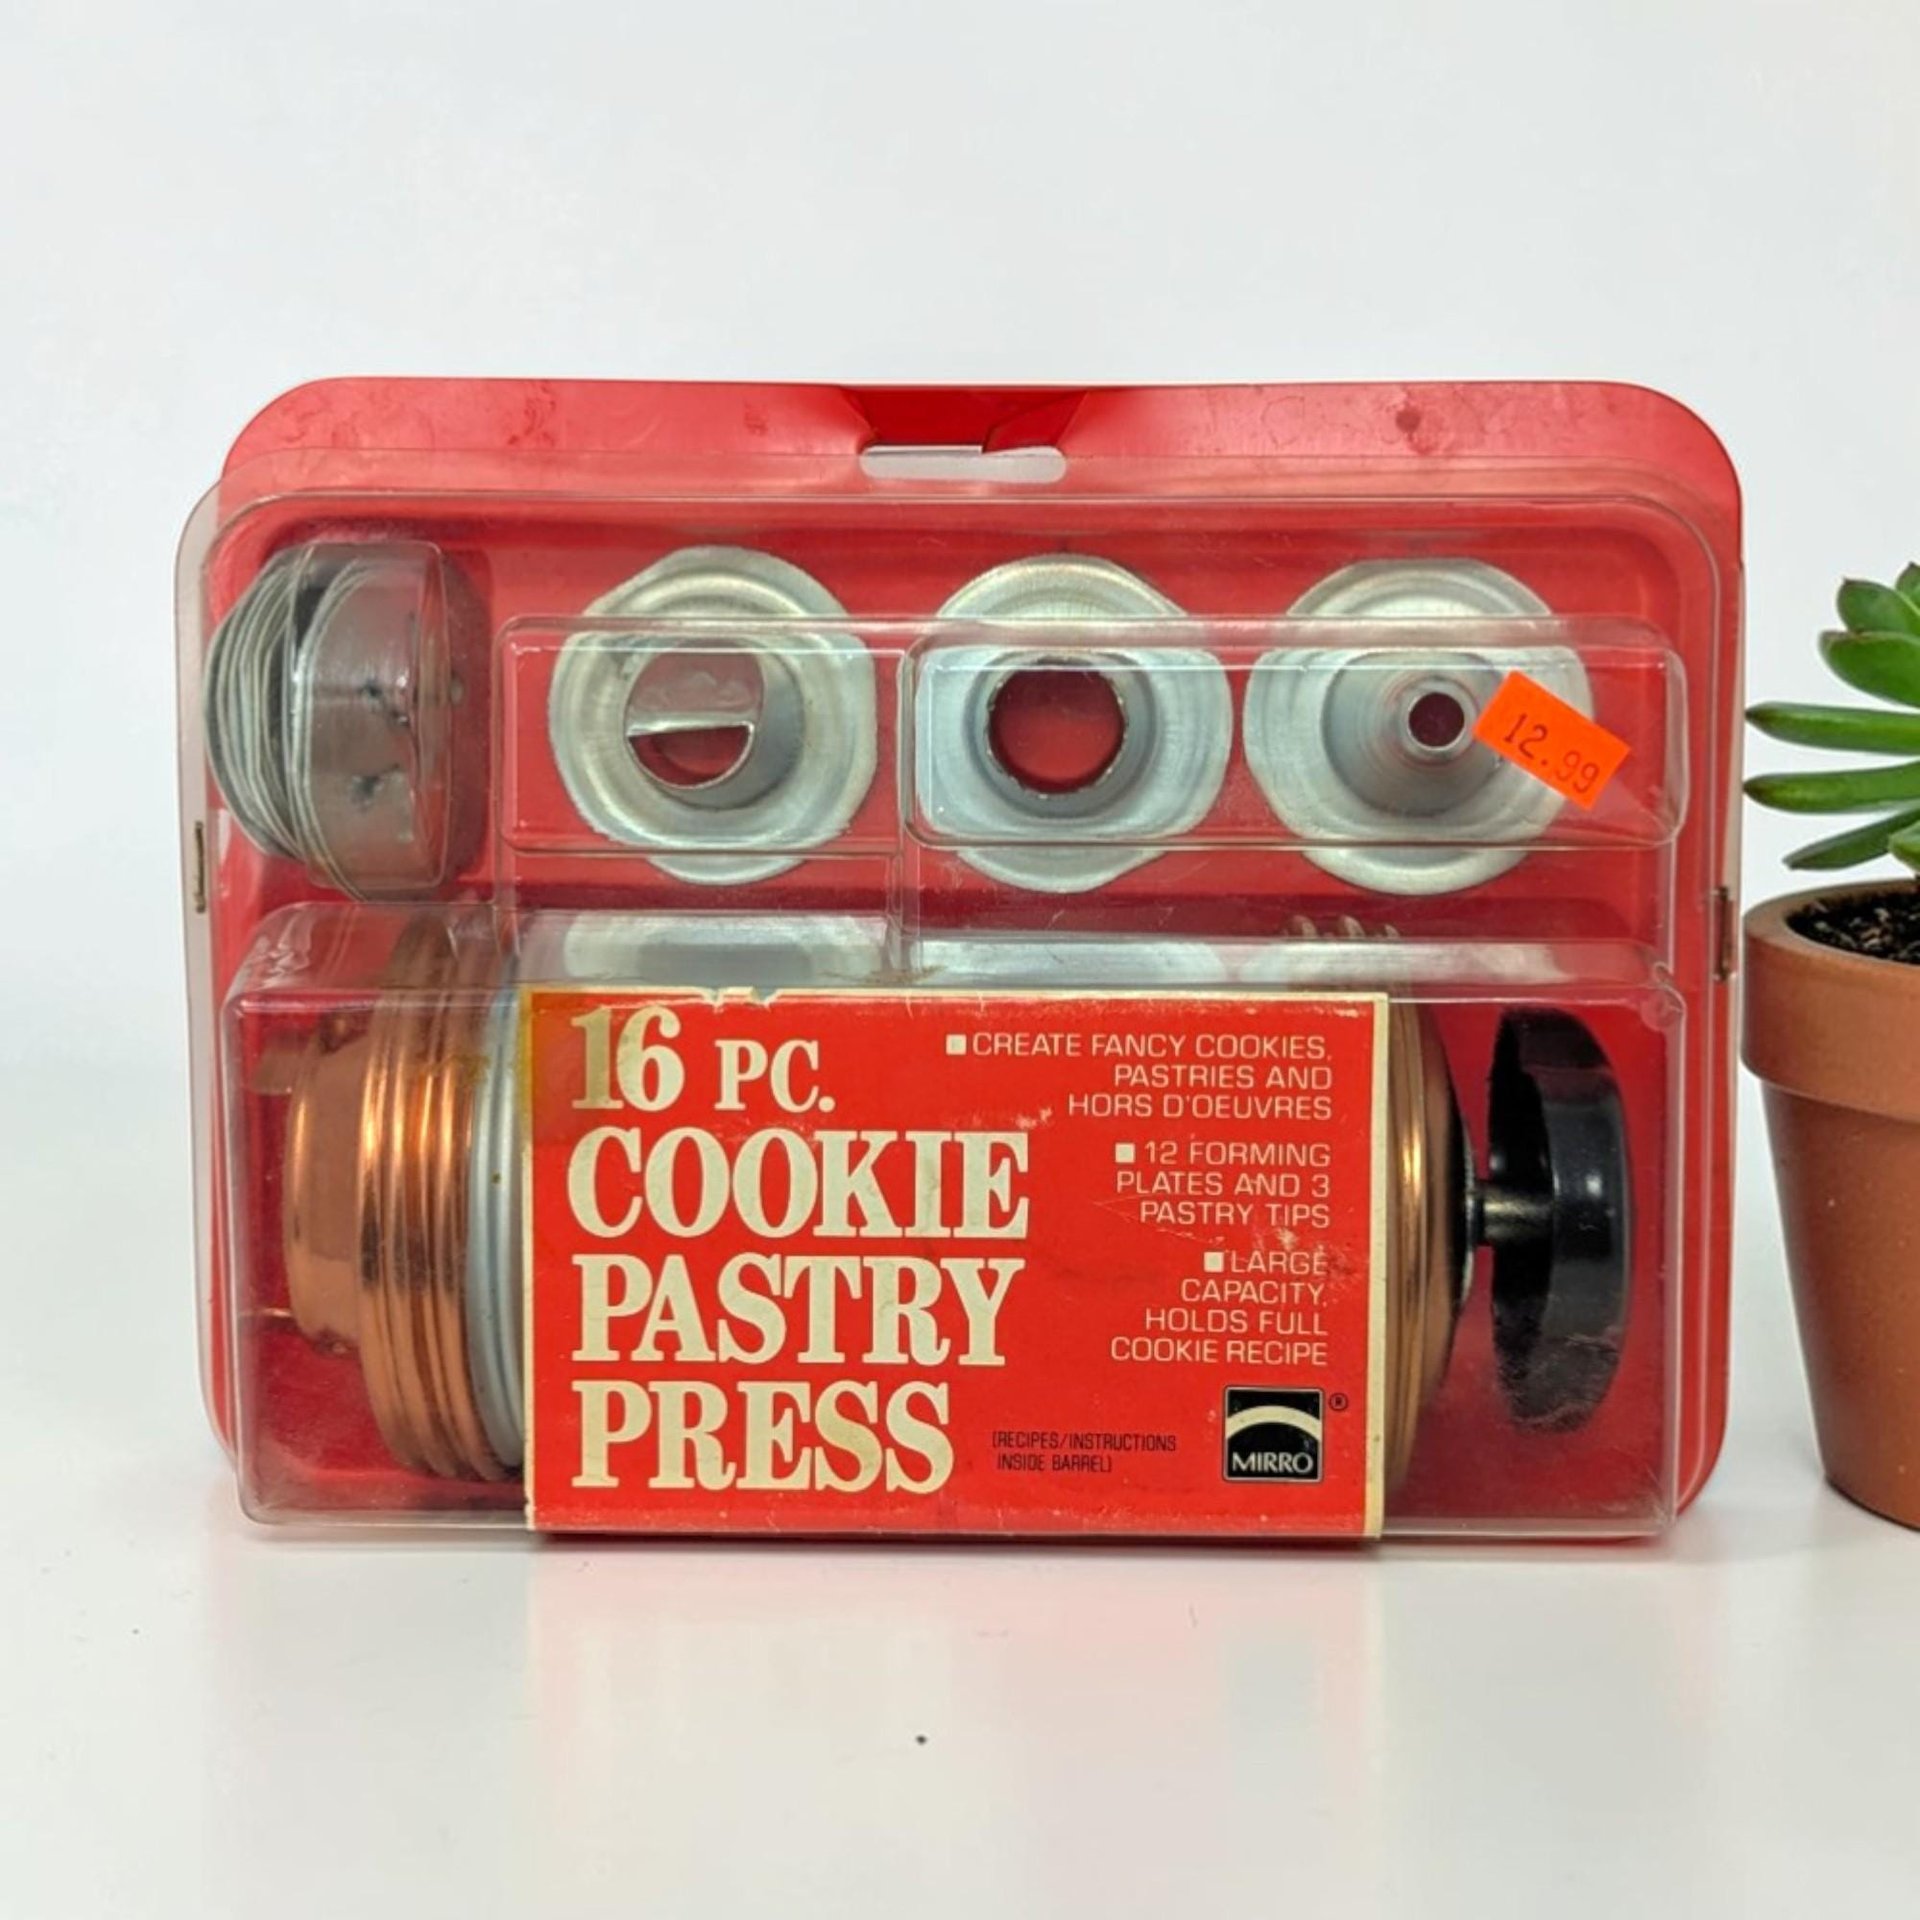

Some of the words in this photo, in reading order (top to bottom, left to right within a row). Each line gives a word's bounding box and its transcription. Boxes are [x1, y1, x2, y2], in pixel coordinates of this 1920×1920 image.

[1503, 712, 1599, 794] 12.99
[973, 1033, 1081, 1056] CREATE
[1091, 1034, 1185, 1058] FANCY
[571, 1006, 685, 1112] 16
[714, 1040, 835, 1112] PC.
[1114, 1064, 1254, 1088] PASTRIES
[1266, 1066, 1332, 1090] AND
[1068, 1094, 1152, 1117] HORS
[1163, 1094, 1332, 1120] D'OEUVRES
[1145, 1141, 1180, 1164] 12
[1189, 1142, 1331, 1167] FORMING
[566, 1127, 1030, 1239] COOKIE
[1116, 1171, 1224, 1195] PLATES
[1234, 1172, 1301, 1197] AND
[1311, 1174, 1330, 1197] 3
[1140, 1202, 1254, 1226] PASTRY
[1264, 1203, 1330, 1228] TIPS
[1231, 1250, 1328, 1275] LARGE
[571, 1252, 1025, 1366] PASTRY
[1145, 1309, 1248, 1333] HOLDS
[1260, 1311, 1328, 1335] FULL
[1110, 1336, 1217, 1362] COOKIE
[1227, 1338, 1328, 1365] RECIPE
[571, 1380, 954, 1494] PRESS
[997, 1454, 1045, 1471] INSIDE
[1232, 1451, 1313, 1473] MIRRO
